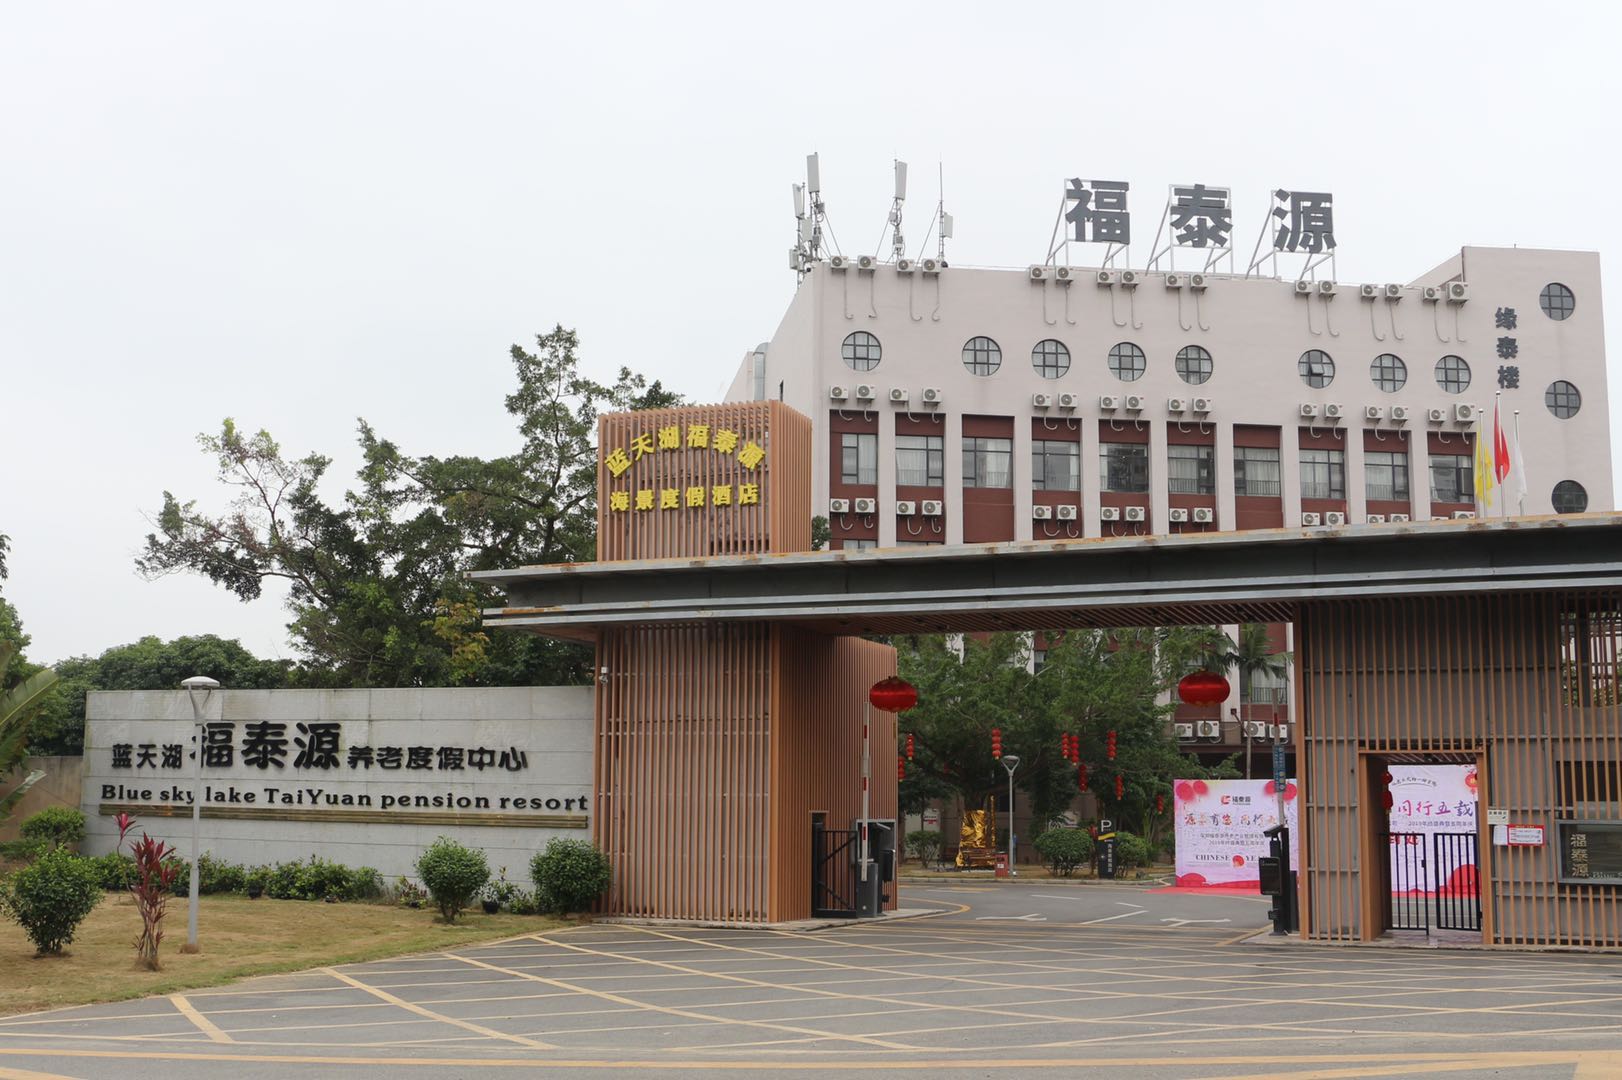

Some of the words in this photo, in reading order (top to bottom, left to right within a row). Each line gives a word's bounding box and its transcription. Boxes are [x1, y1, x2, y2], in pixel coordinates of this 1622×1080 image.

[1064, 177, 1337, 254] 福泰源
[1495, 307, 1520, 389] 缘泰楼
[604, 424, 767, 478] 蓝天湖福泰源
[610, 483, 759, 512] 海景度假酒店
[112, 721, 529, 771] 蓝天湖福泰源养老度假中心
[101, 784, 152, 801] Blue
[159, 785, 196, 804] sky
[205, 786, 256, 804] lake
[264, 788, 372, 807] TaiYuan
[381, 792, 490, 810] pension
[499, 794, 589, 812] resort
[1101, 820, 1112, 832] P
[1195, 854, 1230, 862] CHINESE
[1570, 833, 1589, 877] 福泰源
